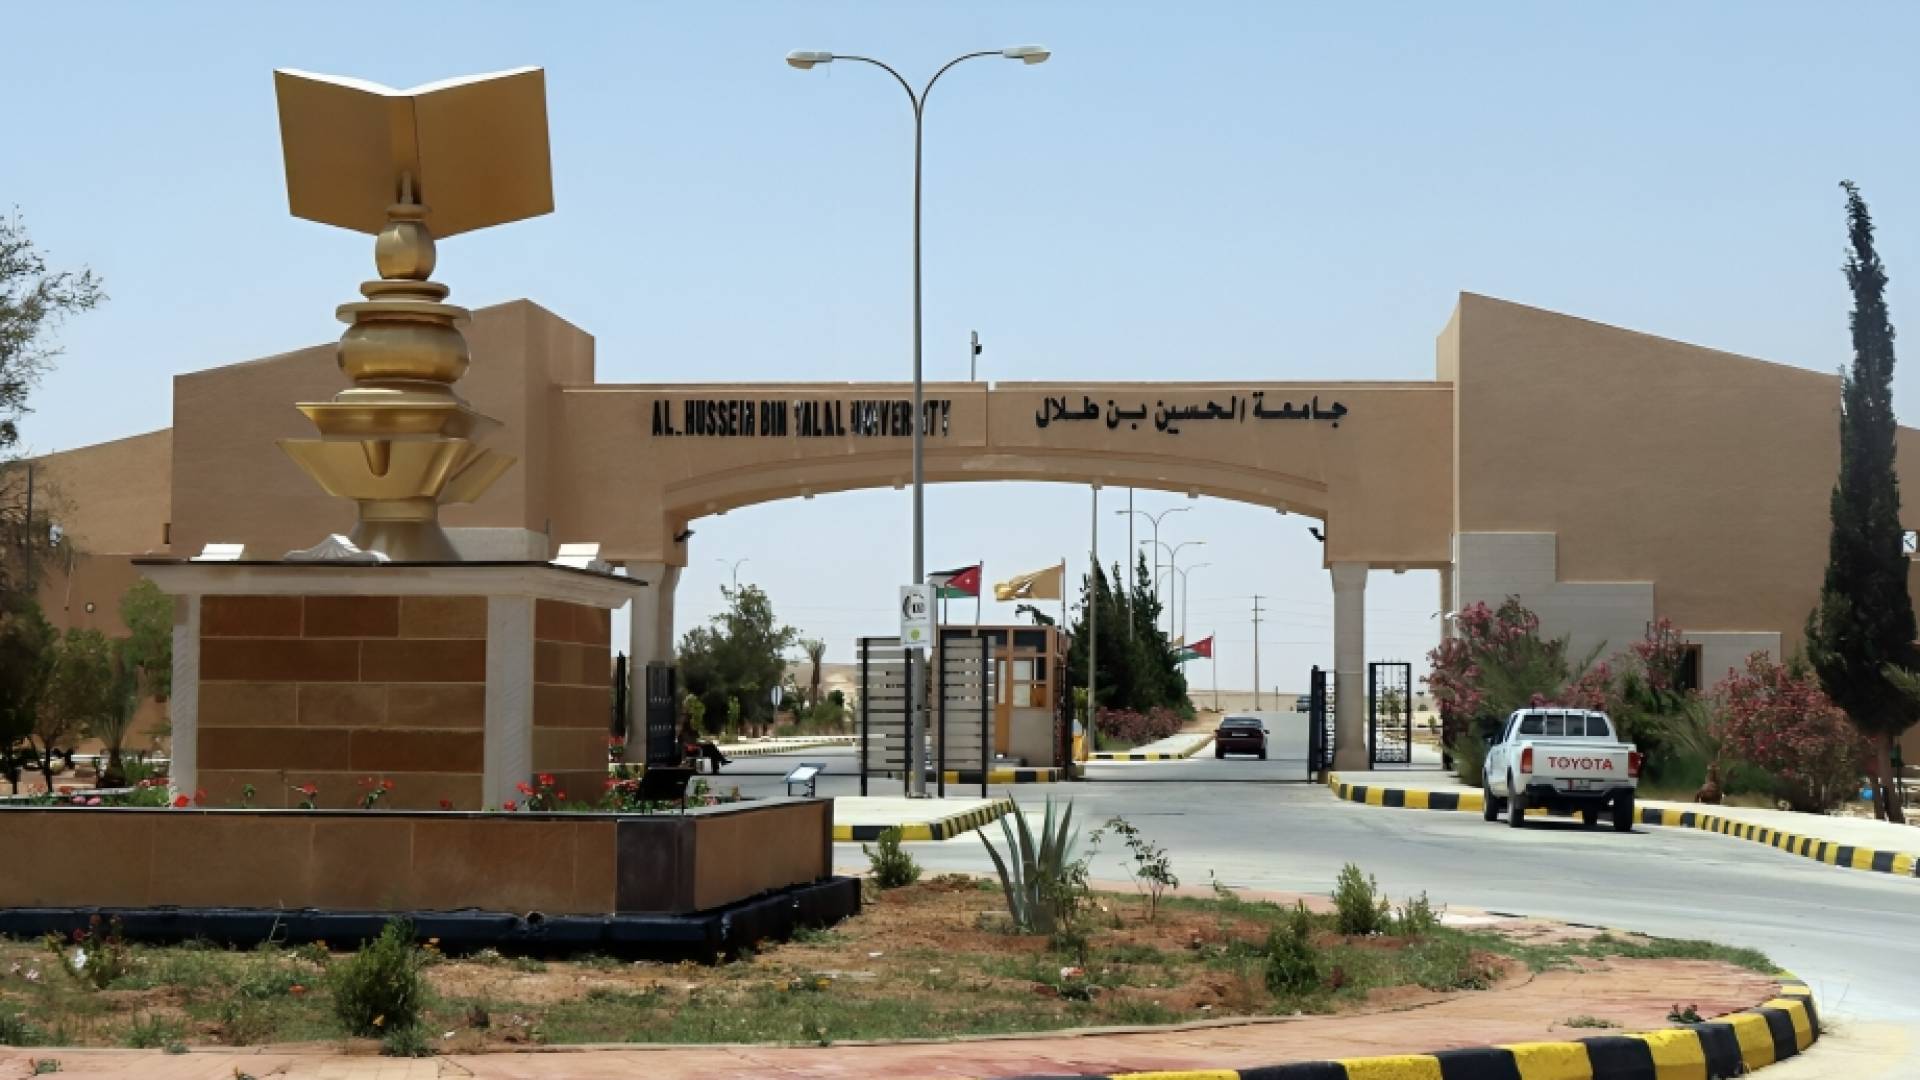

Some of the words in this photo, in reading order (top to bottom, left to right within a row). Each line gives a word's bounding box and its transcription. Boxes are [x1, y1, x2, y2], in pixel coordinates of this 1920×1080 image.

[760, 400, 786, 436] BIN
[1036, 395, 1099, 428] طلال
[1106, 400, 1147, 430] بن
[1155, 395, 1246, 434] الحسين
[1252, 391, 1348, 428] جامعة
[1548, 756, 1613, 770] TOYOTA
